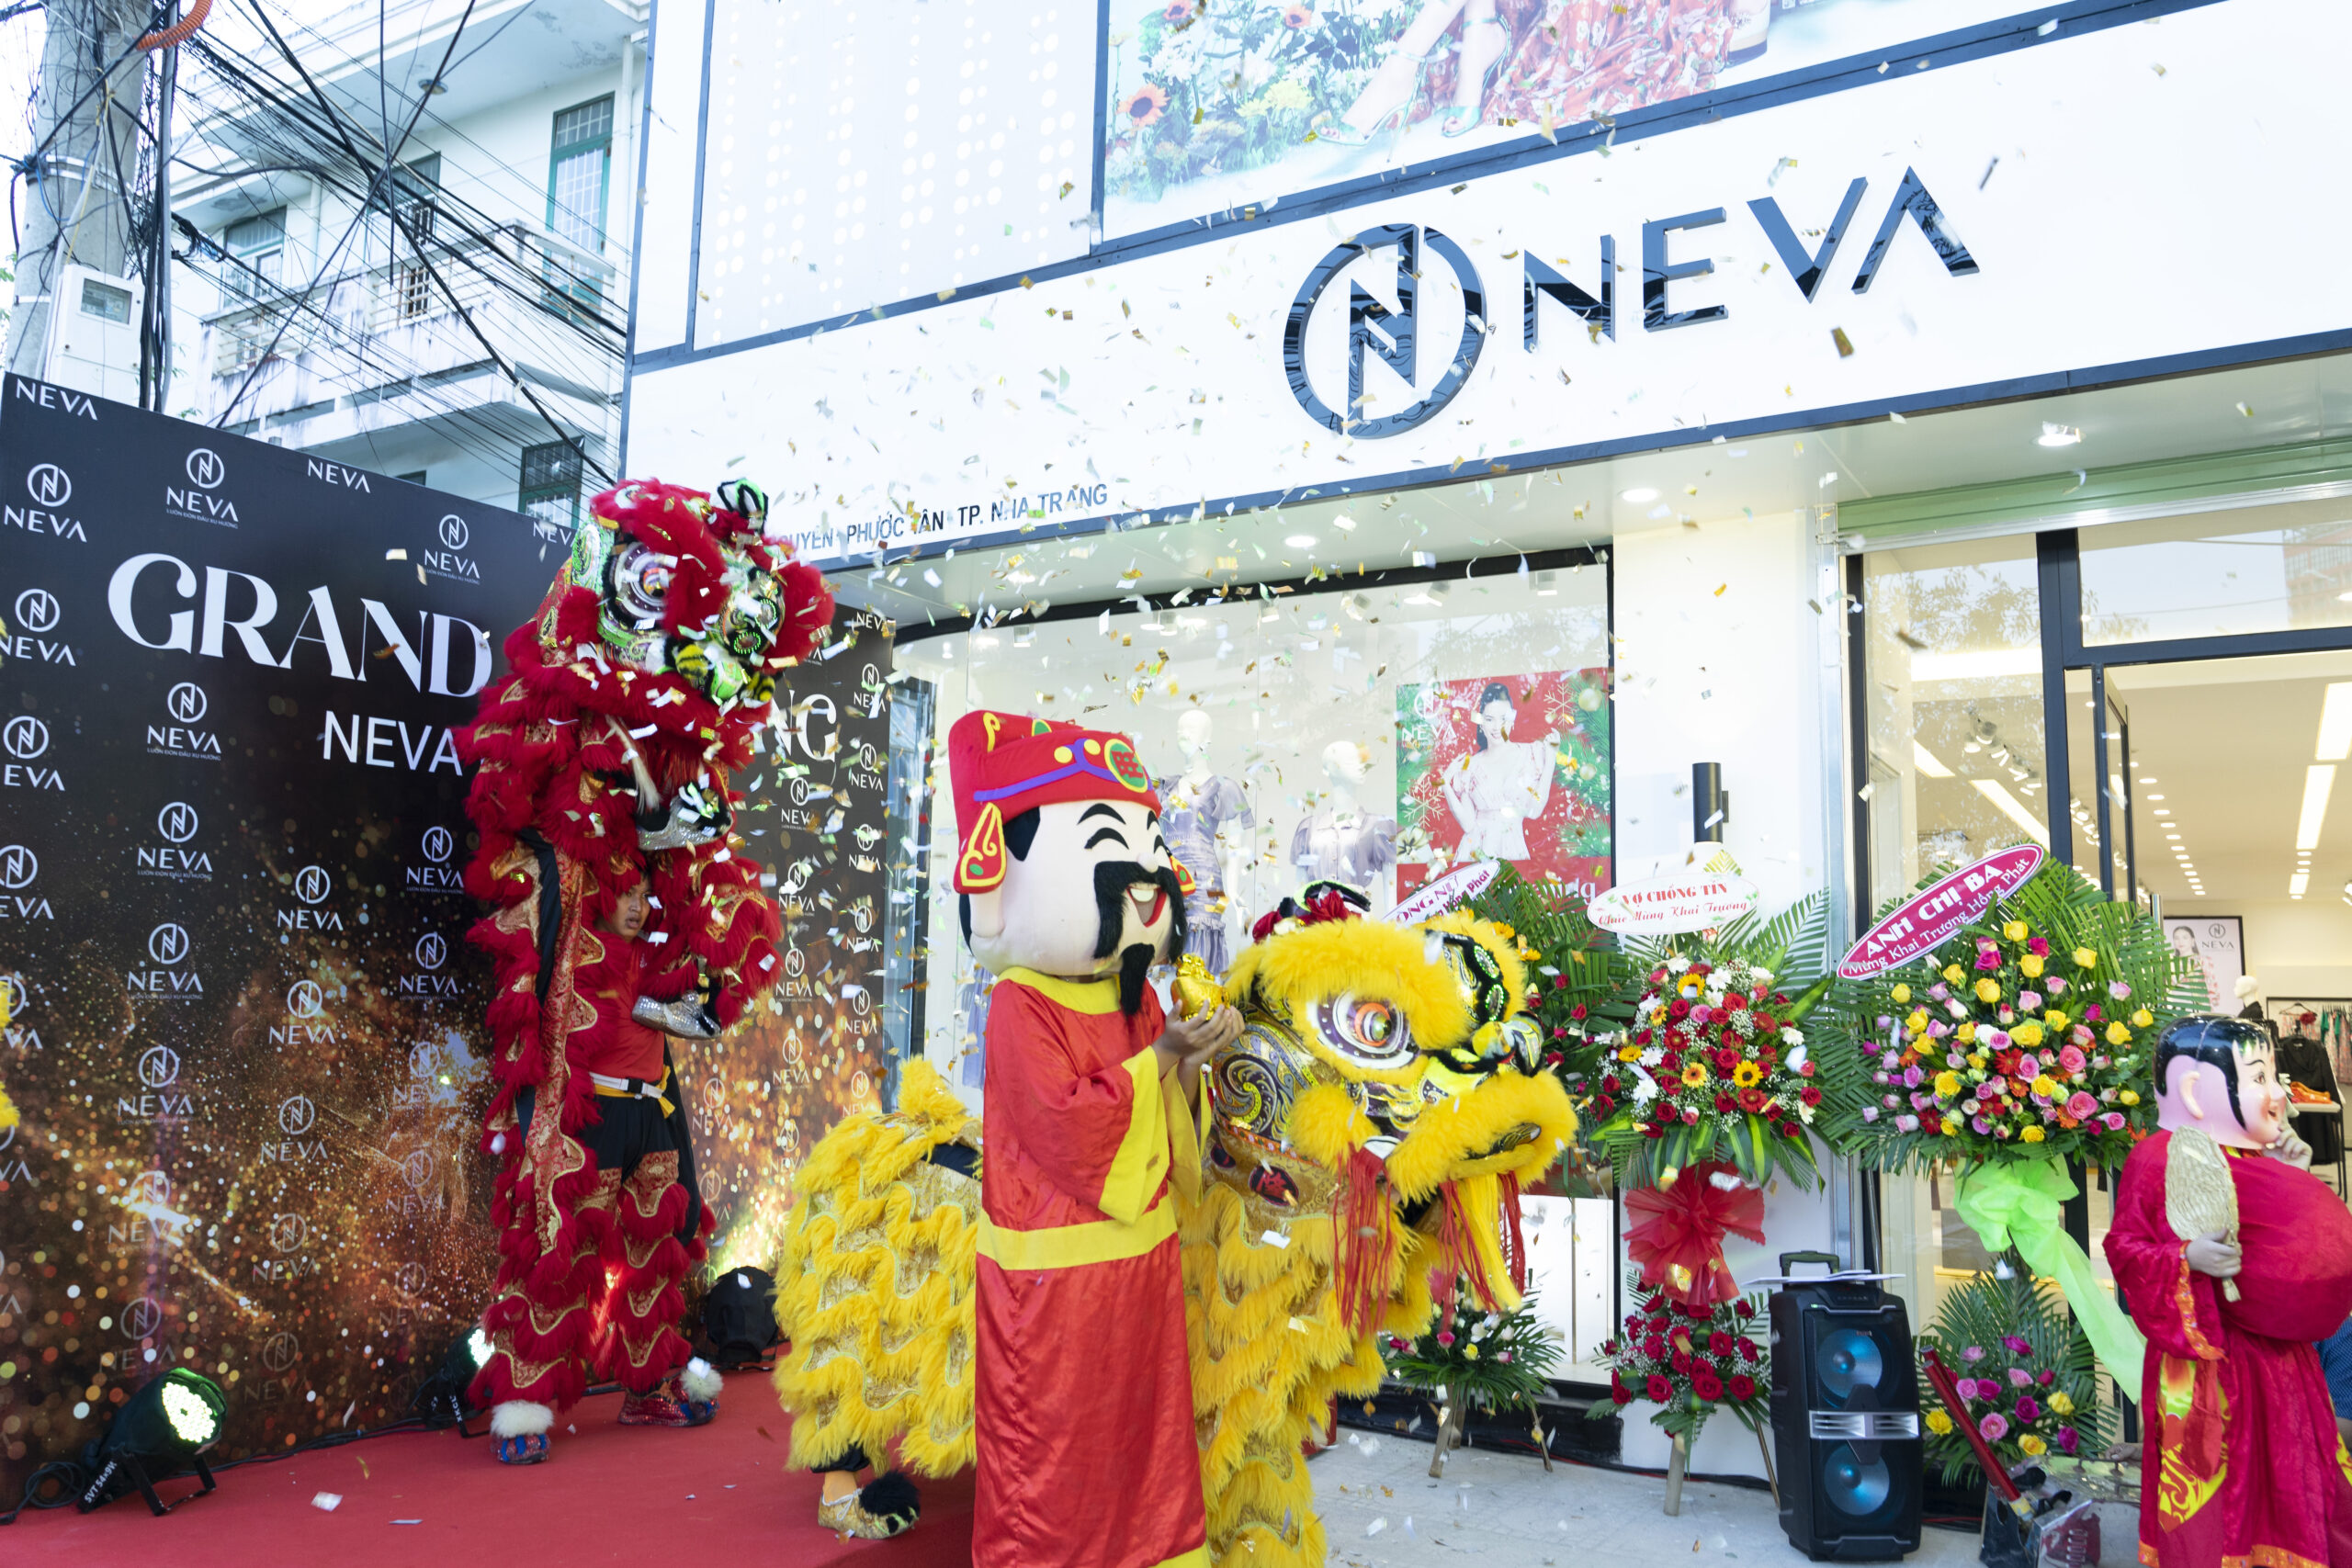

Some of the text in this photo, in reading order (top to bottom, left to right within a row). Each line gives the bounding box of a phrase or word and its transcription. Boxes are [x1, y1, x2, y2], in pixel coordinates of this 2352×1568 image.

[1523, 165, 1981, 354] NEVA
[16, 378, 98, 422] NEVA
[308, 458, 371, 494] NEVA
[166, 485, 239, 523] NEVA
[846, 511, 905, 544] PHƯỚC
[913, 508, 944, 536] ÂN
[957, 504, 984, 527] TP.
[1037, 483, 1108, 515] TRANG
[4, 505, 88, 544] NEVA
[533, 521, 575, 547] NEV
[424, 548, 481, 579] NEVA
[107, 553, 492, 697] GRAND
[856, 612, 887, 632] NEV
[0, 634, 77, 667] NEVA
[854, 692, 887, 714] NEA
[147, 724, 221, 754] NEVA
[323, 710, 464, 777] NEVA
[4, 764, 66, 792] EVA
[851, 773, 884, 792] NEVA
[137, 846, 213, 873] NEVA
[2001, 857, 2030, 885] Phát
[406, 866, 465, 888] NEVA
[0, 895, 54, 919] EVA
[277, 908, 344, 931] NEVA
[1866, 864, 2005, 958] ANH CHỊ BA
[127, 970, 204, 993] NEVA
[400, 975, 458, 994] NEVA
[775, 982, 813, 998] NEVA
[268, 1025, 336, 1045] NEVA
[843, 1020, 877, 1034] NEVA
[773, 1068, 810, 1084] NEVA
[118, 1094, 195, 1117] NEVA
[692, 1114, 734, 1132] NEVA
[260, 1140, 329, 1164] NEVA
[252, 1258, 321, 1283] NEVA
[84, 1482, 98, 1504] SVT
